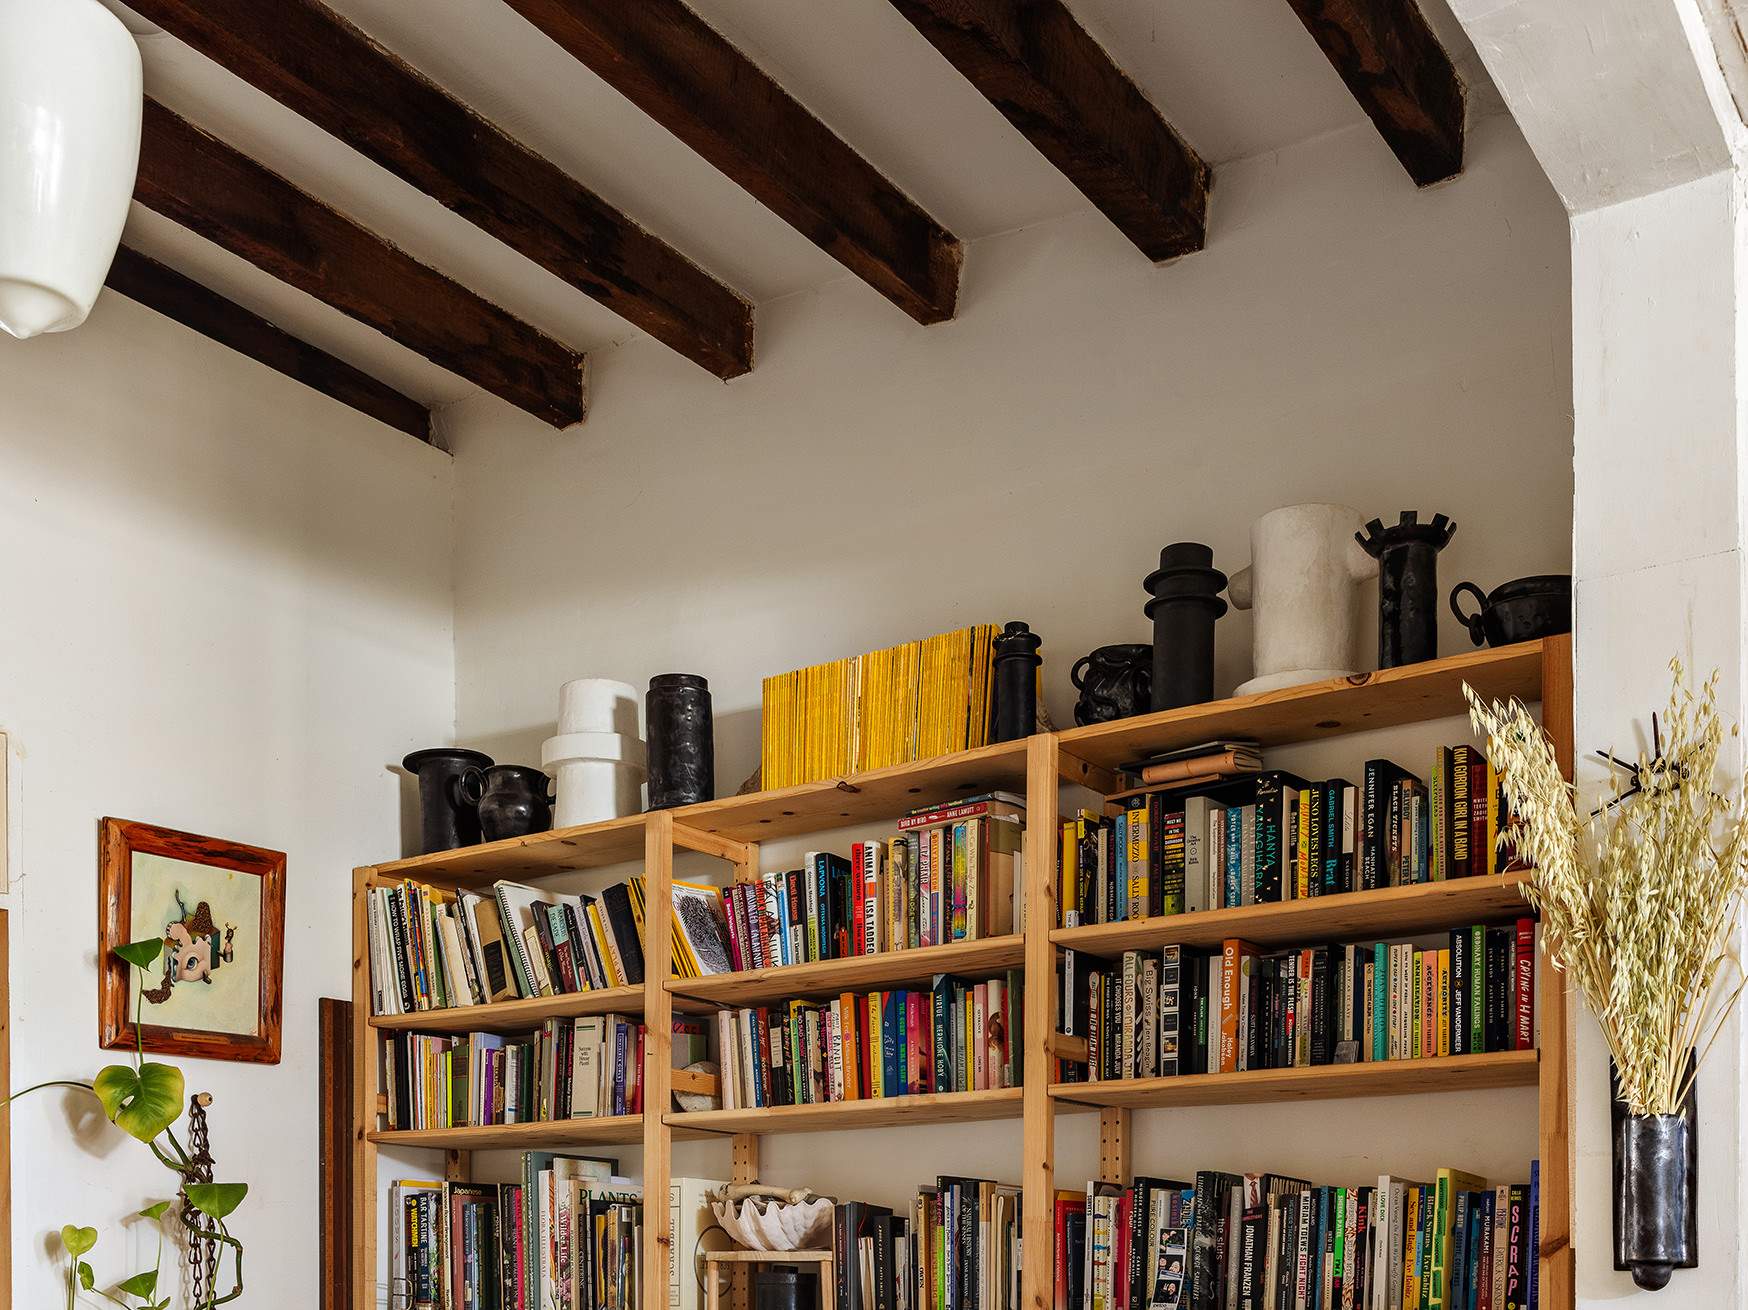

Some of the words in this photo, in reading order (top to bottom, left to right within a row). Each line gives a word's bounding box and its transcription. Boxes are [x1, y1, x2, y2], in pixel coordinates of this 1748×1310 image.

[1453, 748, 1467, 764] KIM
[1453, 766, 1467, 799] GORDON
[1311, 789, 1319, 816] JUNO
[1453, 802, 1467, 819] GIRL
[1131, 811, 1140, 862] INTERMEZZO
[1311, 818, 1319, 850] LOVES
[1453, 821, 1467, 829] IN
[920, 844, 928, 858] LIZ
[1255, 808, 1263, 888] YANAGIHARA
[1266, 825, 1276, 867] HANYA
[1453, 838, 1467, 860] BAND
[864, 846, 873, 880] ANIMAL
[920, 860, 928, 884] PHAIR
[1310, 852, 1319, 878] LEGS
[1325, 859, 1337, 885] Brat
[1131, 876, 1140, 900] SALLY
[390, 901, 398, 918] HOW
[865, 900, 874, 919] LISA
[392, 918, 399, 927] TO
[393, 927, 401, 946] WRAP
[866, 921, 875, 954] TADDEO
[1225, 946, 1234, 967] Old
[397, 961, 406, 980] MORE
[1144, 970, 1153, 985] Big
[1222, 970, 1234, 1010] Enough
[832, 1034, 842, 1071] BANDIT
[579, 1189, 638, 1205] PLANTS
[1426, 1195, 1434, 1220] Black
[1301, 1196, 1310, 1224] MIRIAM
[1357, 1205, 1367, 1233] Kink
[410, 1207, 418, 1247] WATCHMEN
[420, 1213, 428, 1244] TARTINE
[1216, 1218, 1225, 1233] the
[1408, 1219, 1416, 1232] and
[1425, 1221, 1433, 1248] Swans
[1215, 1236, 1225, 1260] sluts
[1244, 1224, 1255, 1261] JONATHAN
[1300, 1227, 1309, 1252] TOEWS
[1406, 1234, 1415, 1253] Rage
[1299, 1254, 1307, 1275] FIGHT
[1423, 1254, 1431, 1270] Eve
[1242, 1262, 1253, 1296] FRANZEN
[1404, 1274, 1413, 1299] Babitz
[1422, 1271, 1430, 1299] Babitz
